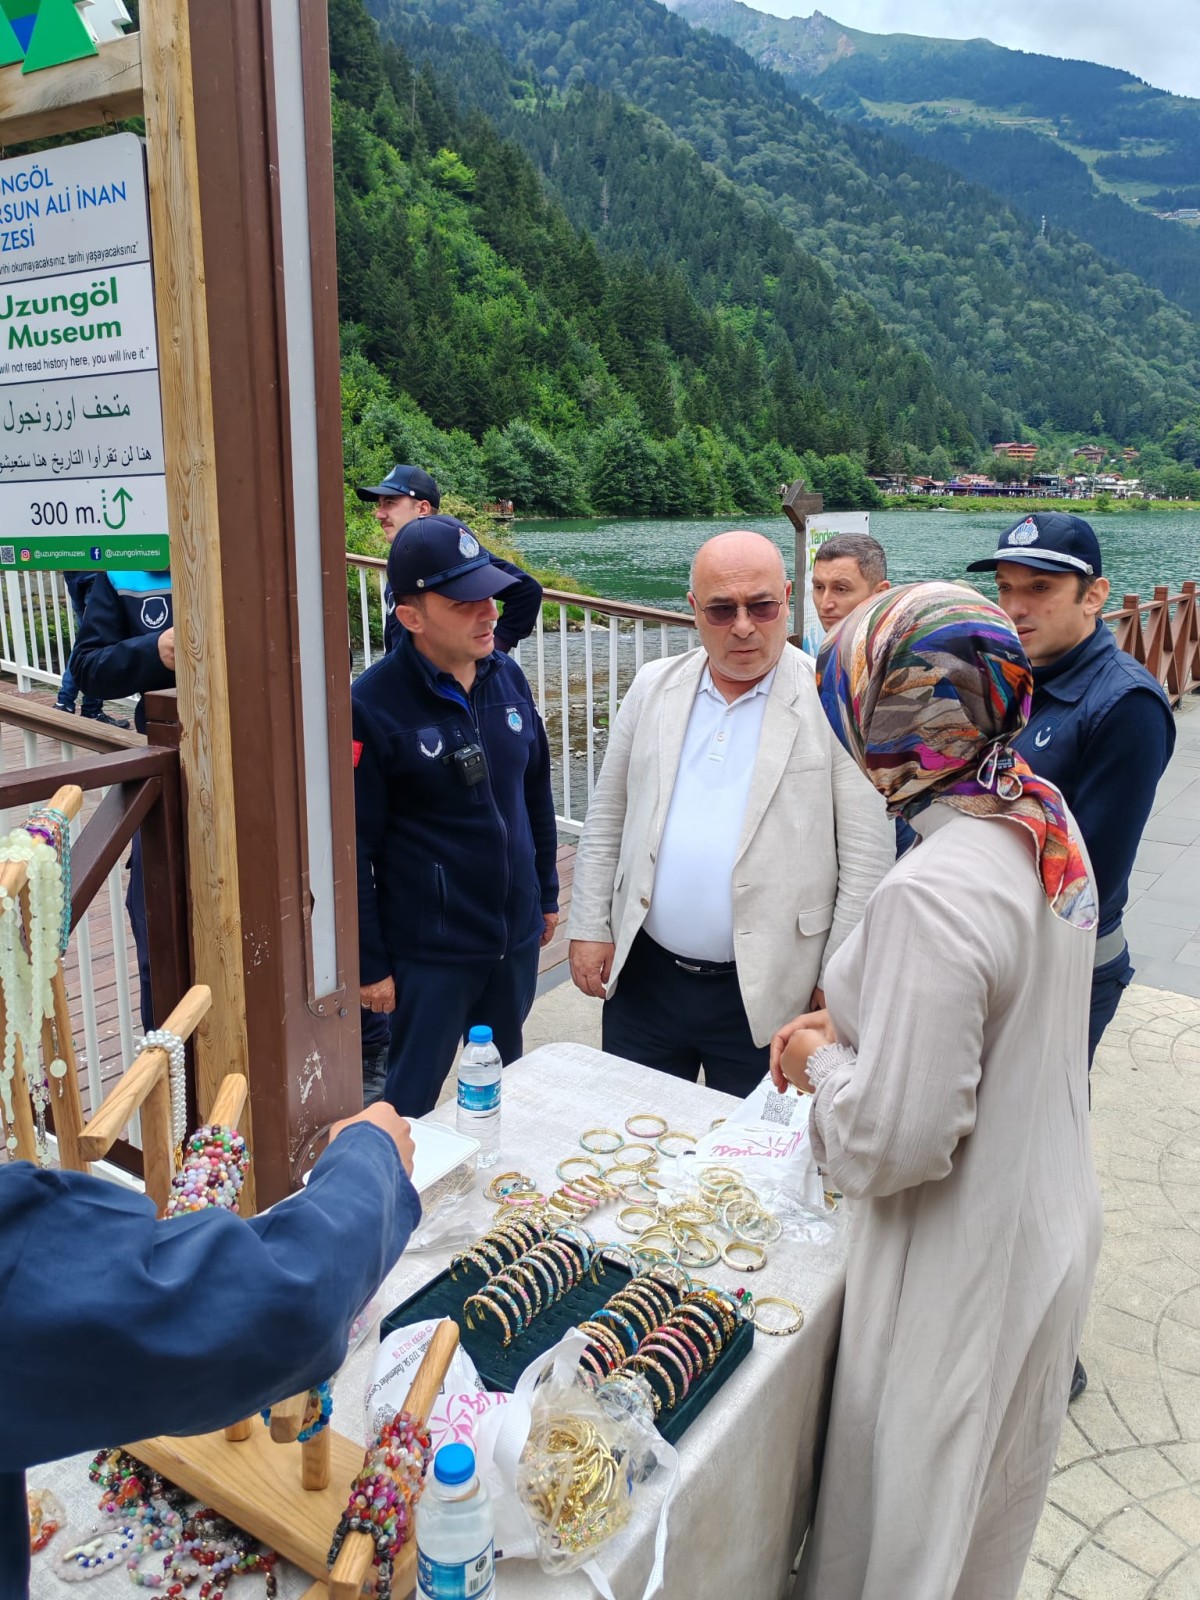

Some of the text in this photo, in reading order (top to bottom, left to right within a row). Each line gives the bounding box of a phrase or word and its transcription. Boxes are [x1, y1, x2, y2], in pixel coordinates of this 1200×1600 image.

[46, 186, 71, 216] ALİ
[76, 180, 127, 210] İNAN
[68, 252, 85, 265] tarihi
[8, 320, 122, 350] Museum
[11, 362, 24, 373] not
[25, 359, 42, 371] read
[43, 356, 68, 370] history
[69, 355, 91, 367] here,
[92, 355, 107, 367] you
[108, 349, 121, 362] will
[122, 348, 137, 361] live
[3, 394, 131, 433] متحف اوزونجول
[32, 452, 47, 467] هنا
[51, 448, 84, 474] التاريخ
[121, 445, 134, 467] لن
[136, 446, 152, 461] هنا
[30, 501, 101, 526] 300 m.
[34, 547, 161, 560] @uzungolmuzesi @uzungolmuzesi
